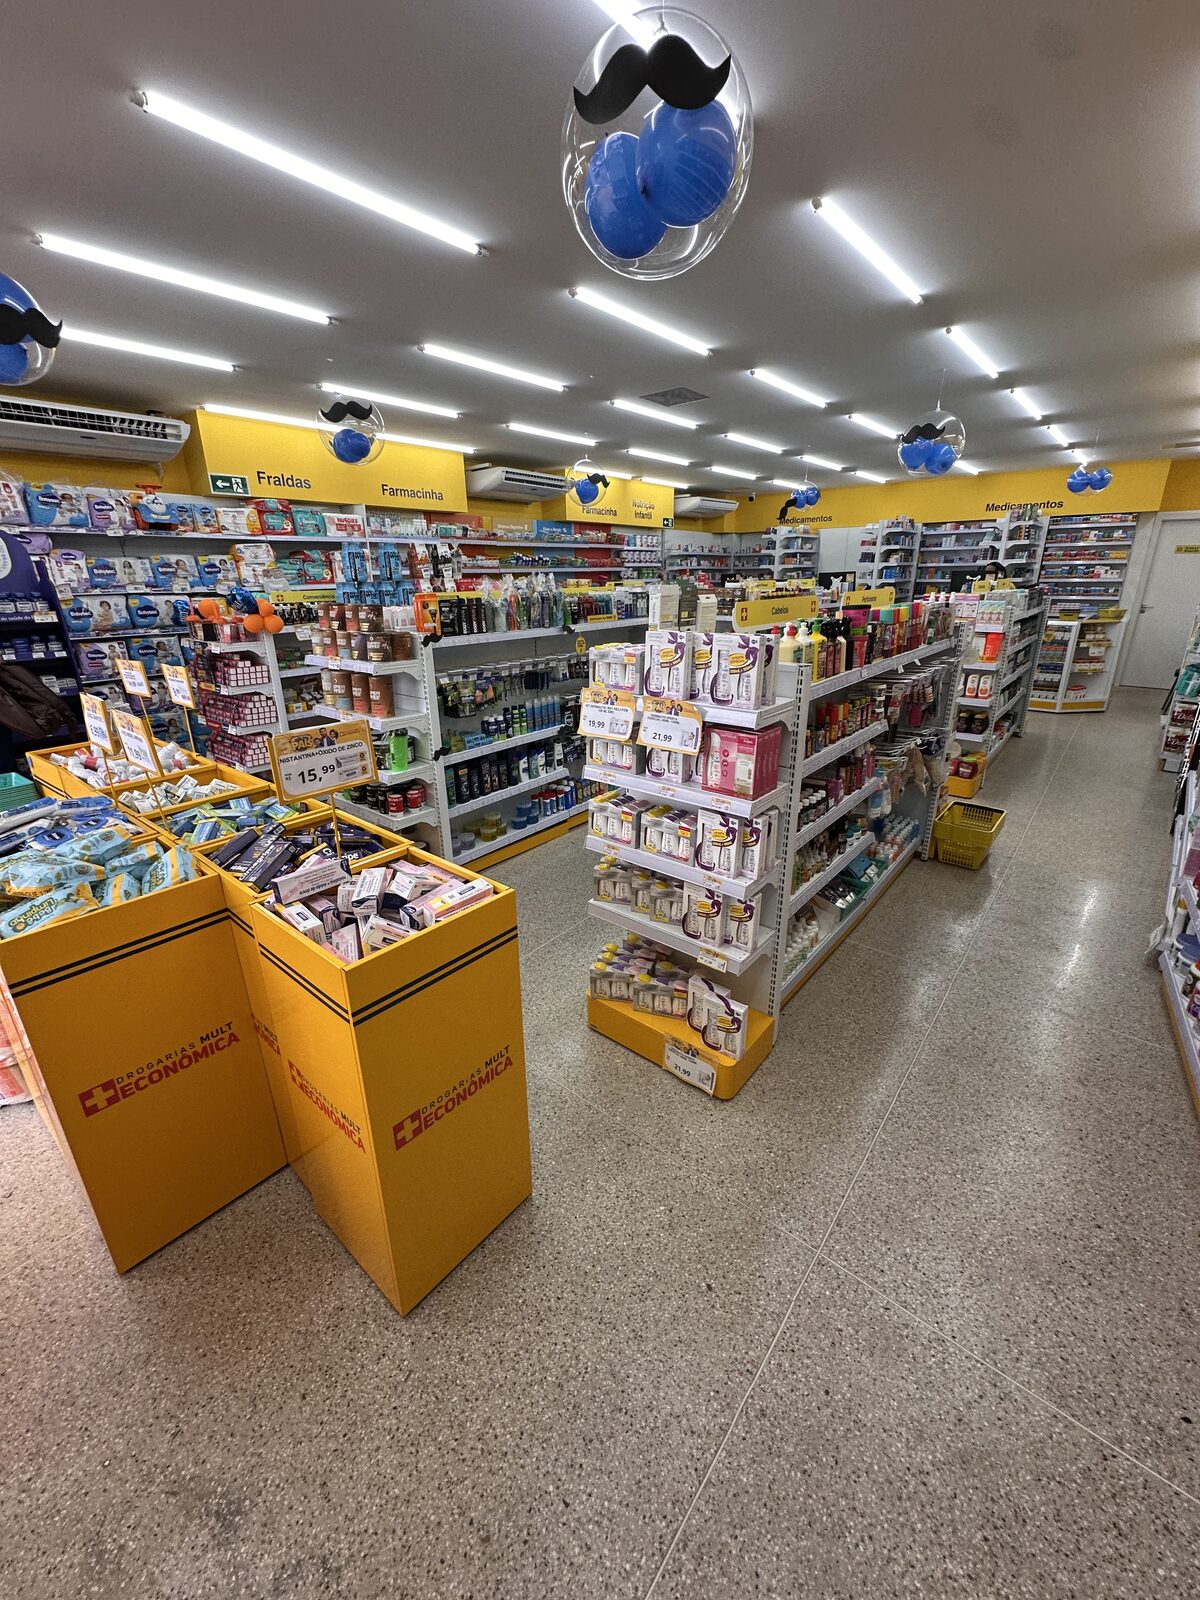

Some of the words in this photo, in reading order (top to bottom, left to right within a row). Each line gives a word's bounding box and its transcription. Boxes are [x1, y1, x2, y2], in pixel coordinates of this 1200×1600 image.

[256, 470, 312, 490] Fraldas
[381, 483, 444, 501] Farmacinha
[581, 504, 618, 517] Farmacinha
[634, 510, 653, 520] Infantil
[771, 606, 789, 616] Cabelos
[588, 719, 605, 728] 19,99
[347, 741, 363, 750] ZINCO
[652, 732, 672, 742] 21,99
[297, 764, 336, 784] 15,99
[116, 1042, 196, 1085] DROGARIAS
[199, 1021, 233, 1044] MULT
[119, 1032, 241, 1100] ECONÔMICA
[421, 1067, 481, 1115] DROGARIAS
[484, 1044, 511, 1069] MULT
[423, 1055, 514, 1131] ECONÔMICA
